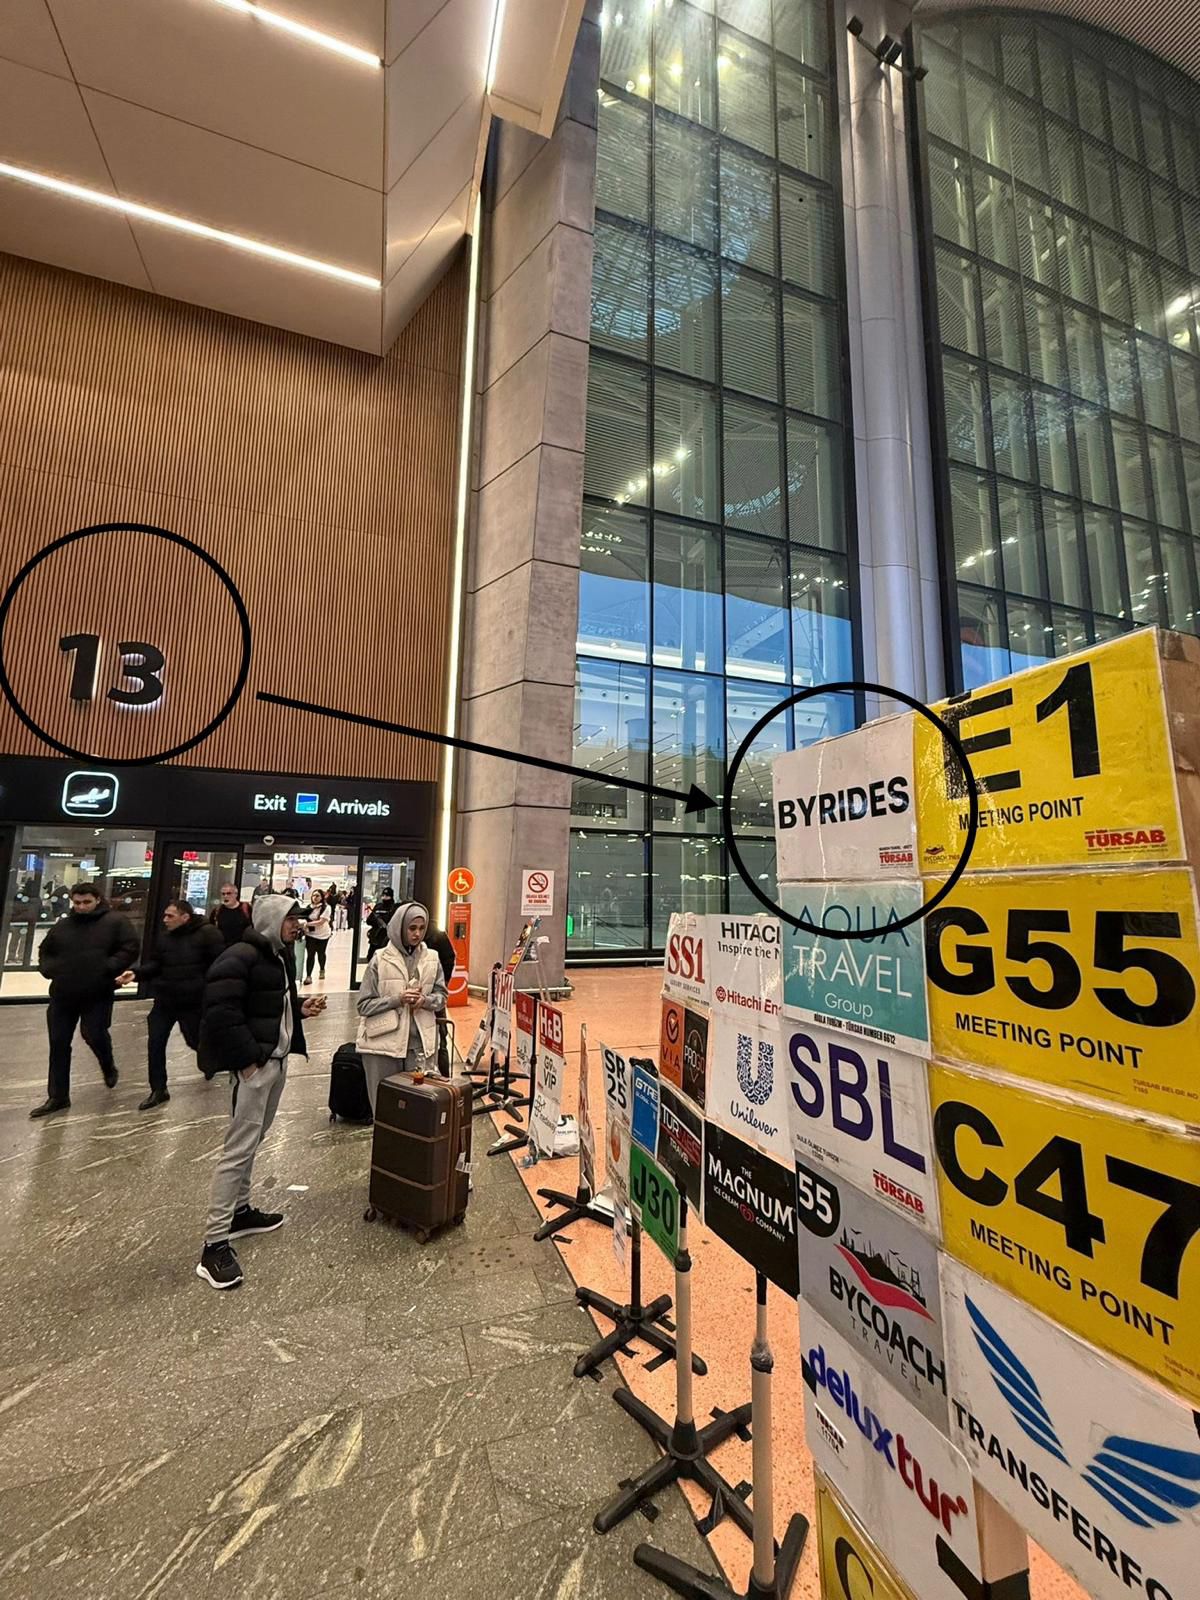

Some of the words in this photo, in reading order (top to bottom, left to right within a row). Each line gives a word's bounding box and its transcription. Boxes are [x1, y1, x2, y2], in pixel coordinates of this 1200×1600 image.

[58, 632, 165, 709] 13
[941, 661, 1101, 801] E1
[253, 794, 287, 812] Exit
[327, 798, 391, 817] Arrivals
[778, 776, 910, 829] BYRIDES
[958, 804, 1024, 831] METING
[1029, 796, 1084, 822] POINT
[1085, 828, 1166, 848] TÜRSAB
[792, 905, 910, 947] AQUA
[667, 933, 705, 984] SS1
[717, 941, 752, 956] Inspire
[755, 945, 771, 959] the
[792, 929, 912, 998] TRAVEL
[925, 906, 1196, 1028] G55
[727, 990, 762, 1011] Hitachi
[824, 992, 873, 1020] Group
[662, 1045, 681, 1070] VIA
[955, 1012, 1052, 1048] MEETING
[1059, 1032, 1143, 1068] POINT
[543, 1068, 557, 1091] VIP
[604, 1049, 627, 1086] SR
[607, 1075, 628, 1110] 25
[789, 1033, 926, 1175] SBL
[730, 1100, 778, 1137] Unilever
[708, 1151, 795, 1235] MAGNUM
[740, 1166, 752, 1180] THE
[872, 1172, 925, 1214] TÜRSAB
[634, 1163, 675, 1237] J30
[713, 1184, 722, 1197] ICE
[721, 1190, 739, 1209] CREAM
[799, 1169, 833, 1225] 55
[933, 1100, 1200, 1301] C47
[755, 1216, 786, 1243] COMPANY
[970, 1218, 1072, 1291] MEETING
[1080, 1277, 1175, 1346] POINT
[829, 1265, 948, 1398] BYCOACH
[850, 1316, 922, 1393] TRAVEL
